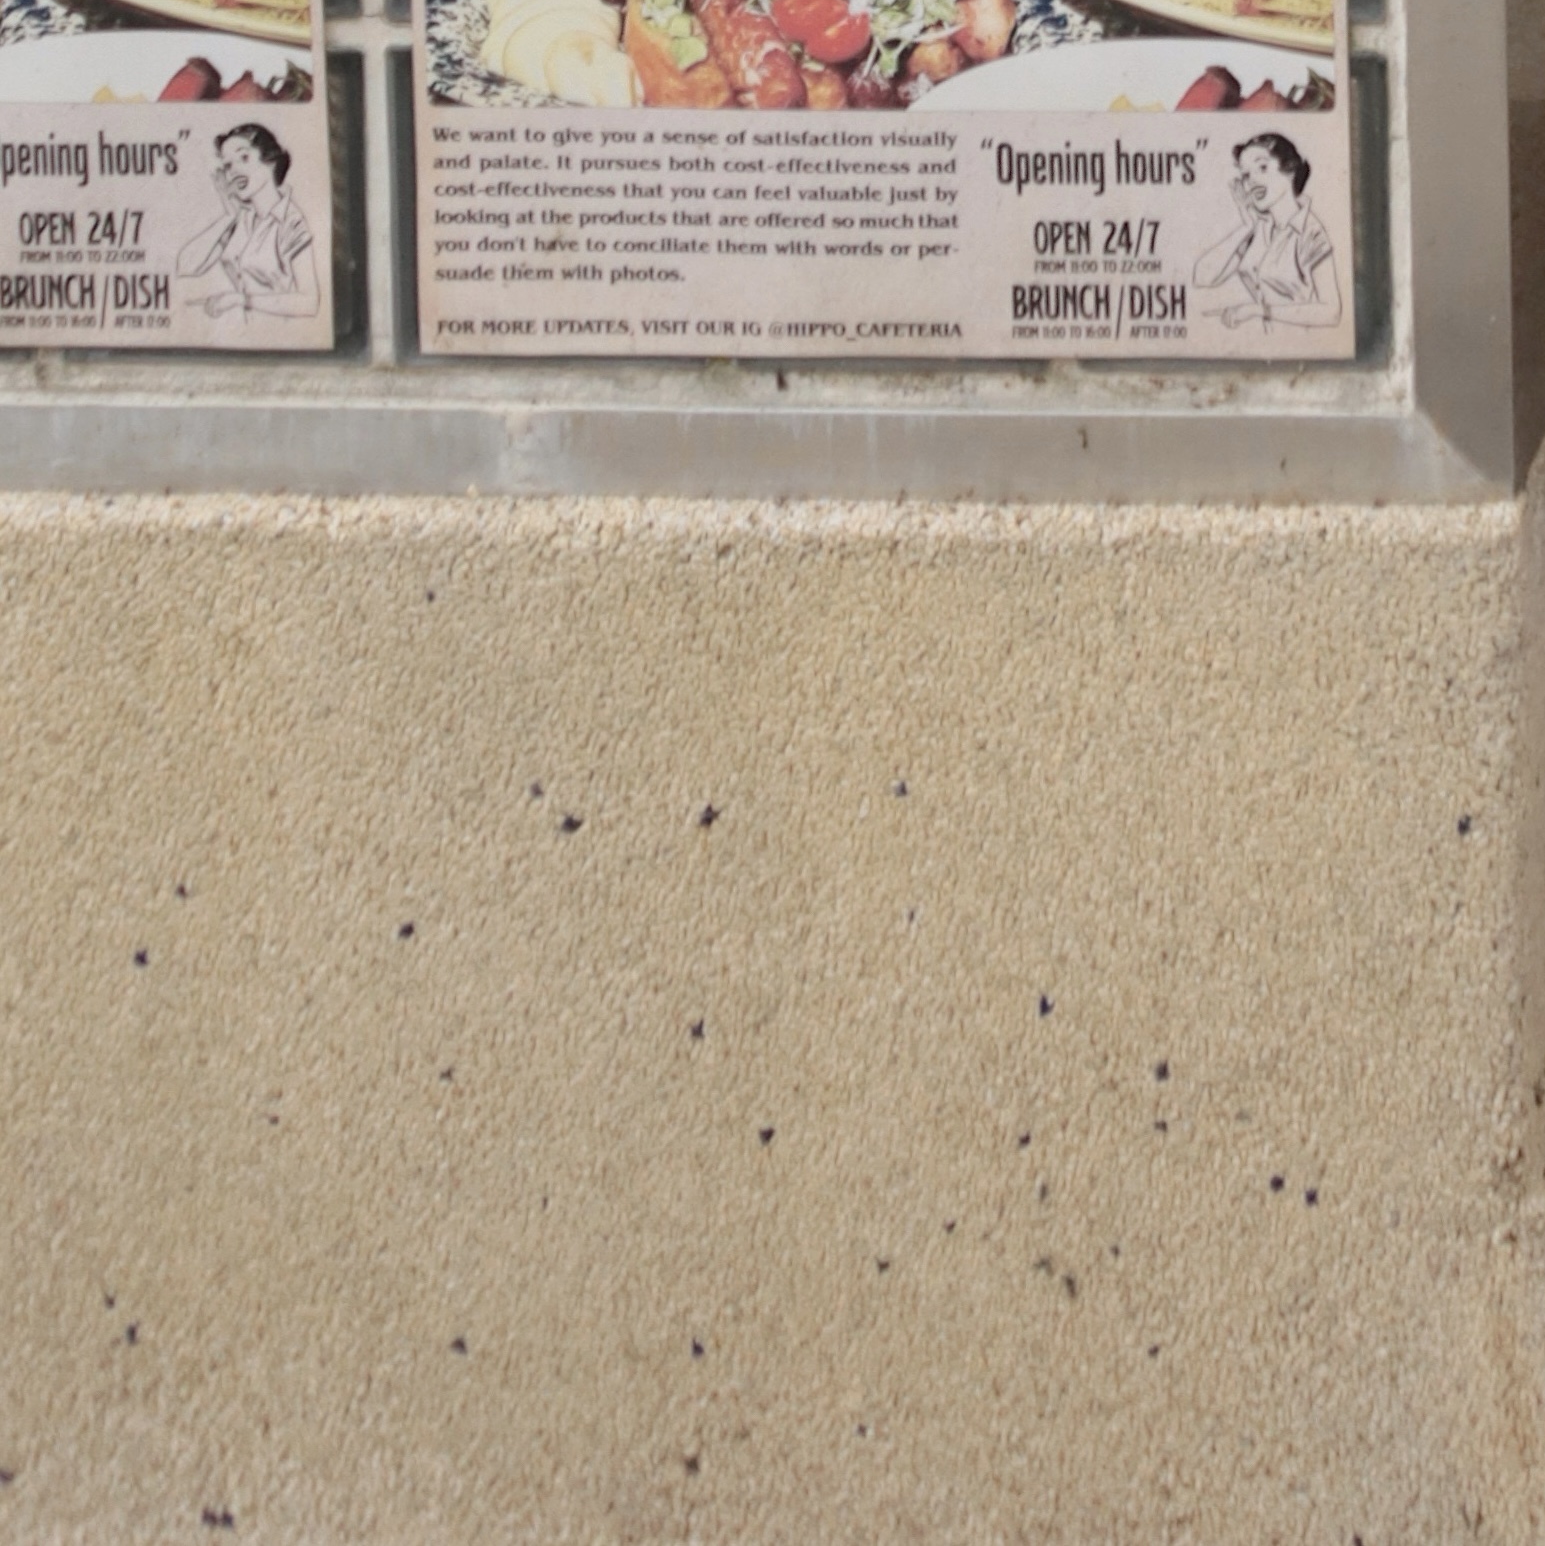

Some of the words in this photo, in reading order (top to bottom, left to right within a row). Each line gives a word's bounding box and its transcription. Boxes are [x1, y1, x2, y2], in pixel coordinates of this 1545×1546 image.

[431, 126, 461, 144] We
[468, 127, 517, 144] want
[524, 127, 547, 144] to
[551, 127, 593, 149] give
[600, 130, 637, 148] you
[642, 131, 655, 145] a
[661, 131, 719, 146] sense
[725, 129, 747, 147] of
[752, 130, 874, 148] satisfaction
[880, 130, 958, 152] visually
[0, 131, 90, 189] pening
[432, 153, 472, 171] and
[479, 153, 549, 175] palate.
[556, 154, 571, 172] It
[580, 157, 662, 176] pursues
[668, 155, 716, 173] both
[722, 157, 911, 176] cost-effectiveness
[917, 157, 957, 176] and
[433, 180, 617, 199] cost-effectiveness
[622, 182, 663, 200] that
[670, 186, 706, 203] you
[712, 187, 748, 201] can
[754, 184, 791, 202] feel
[797, 184, 882, 203] valuable
[887, 185, 927, 207] just
[934, 185, 959, 207] by
[18, 211, 76, 246] OPEN
[87, 208, 144, 249] 24/7
[434, 208, 511, 230] looking
[515, 209, 535, 226] at
[540, 208, 573, 226] the
[579, 209, 667, 230] products
[672, 210, 711, 228] that
[718, 214, 749, 228] are
[754, 211, 826, 230] offered
[831, 216, 856, 230] so
[858, 213, 915, 231] much
[917, 213, 959, 230] that
[434, 239, 471, 257] you
[476, 235, 526, 253] don't
[533, 234, 579, 255] have
[585, 237, 607, 254] to
[612, 237, 710, 255] conciliate
[716, 238, 768, 256] them
[774, 239, 817, 257] with
[823, 239, 884, 258] words
[889, 244, 912, 258] or
[918, 243, 958, 262] per-
[1033, 220, 1091, 256] OPEN
[1103, 218, 1161, 258] 24/7
[434, 264, 495, 283] suade
[501, 262, 555, 282] them
[560, 263, 603, 282] with
[609, 264, 685, 287] photos.
[436, 319, 476, 337] FOR
[481, 319, 536, 336] MORE
[543, 319, 634, 336] UPDATES,
[641, 319, 689, 335] VISIT
[695, 320, 735, 336] OUR
[741, 321, 762, 336] IG
[768, 321, 963, 342] @HIPPO_CAFETERIA
